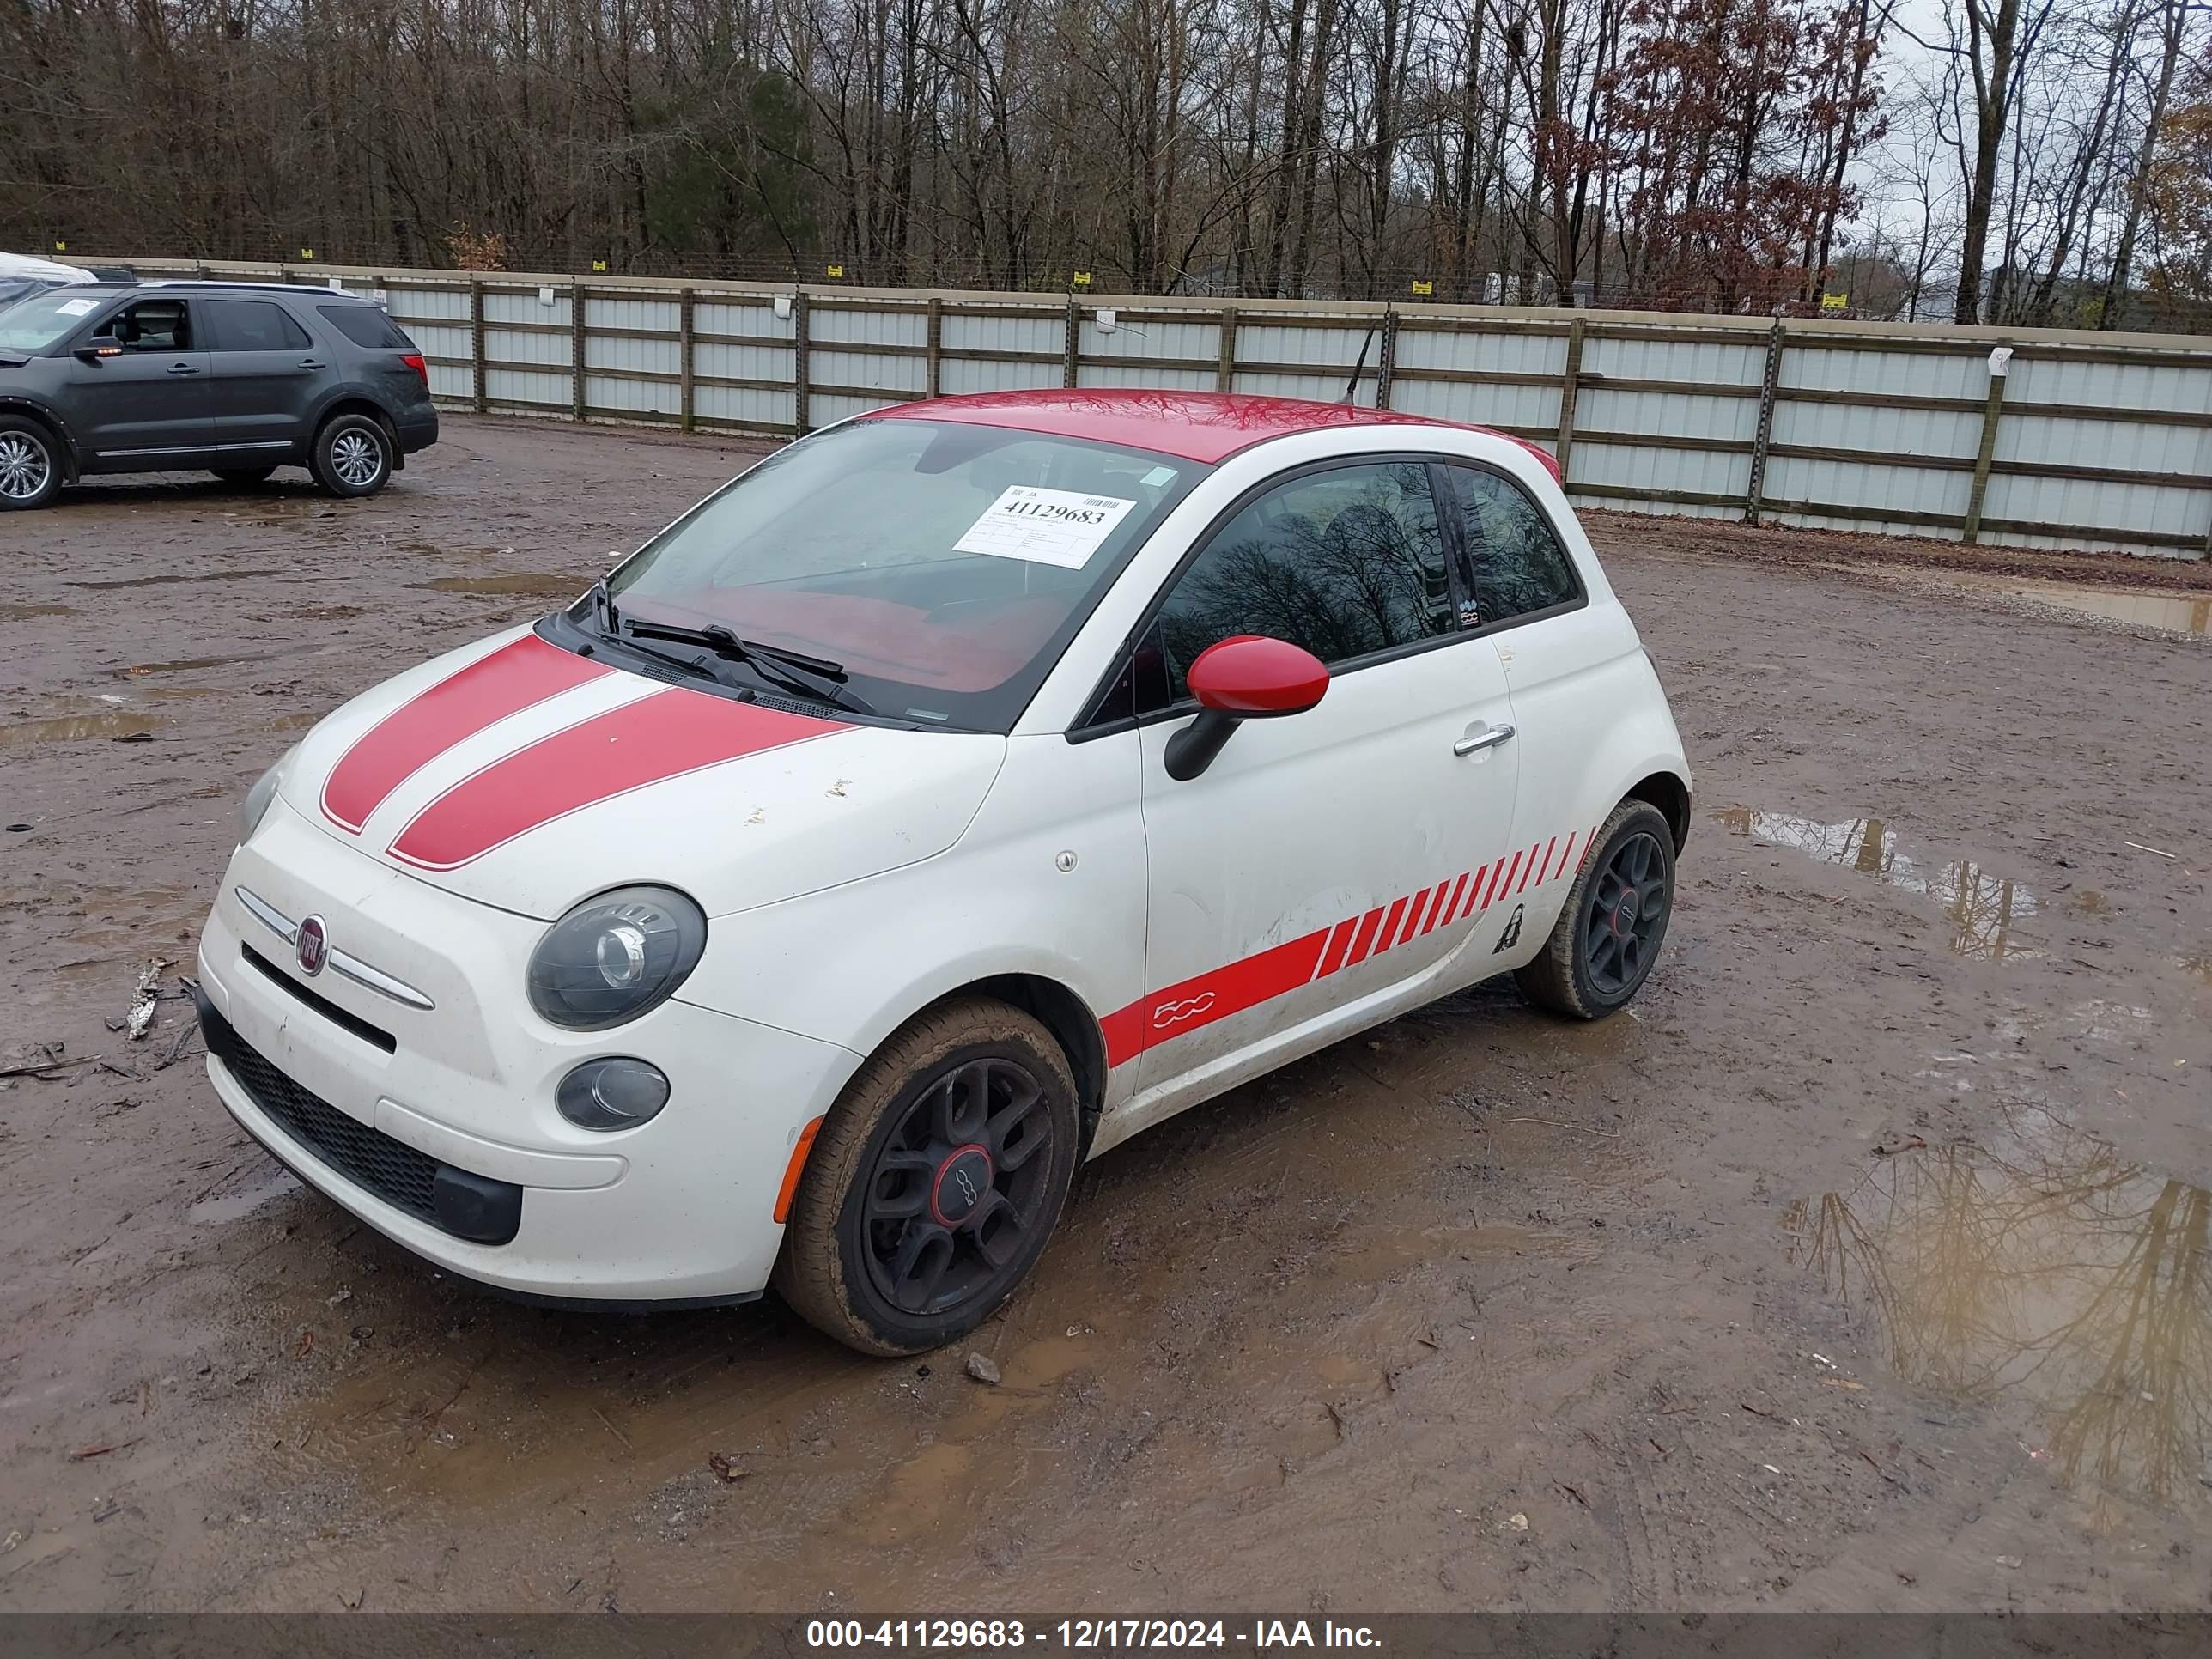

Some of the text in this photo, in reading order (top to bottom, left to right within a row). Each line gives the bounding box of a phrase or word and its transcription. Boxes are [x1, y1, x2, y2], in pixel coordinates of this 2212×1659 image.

[1004, 501, 1106, 525] 41129683
[301, 930, 322, 963] FIAT
[1153, 992, 1216, 1029] 500
[955, 1169, 978, 1207] 500
